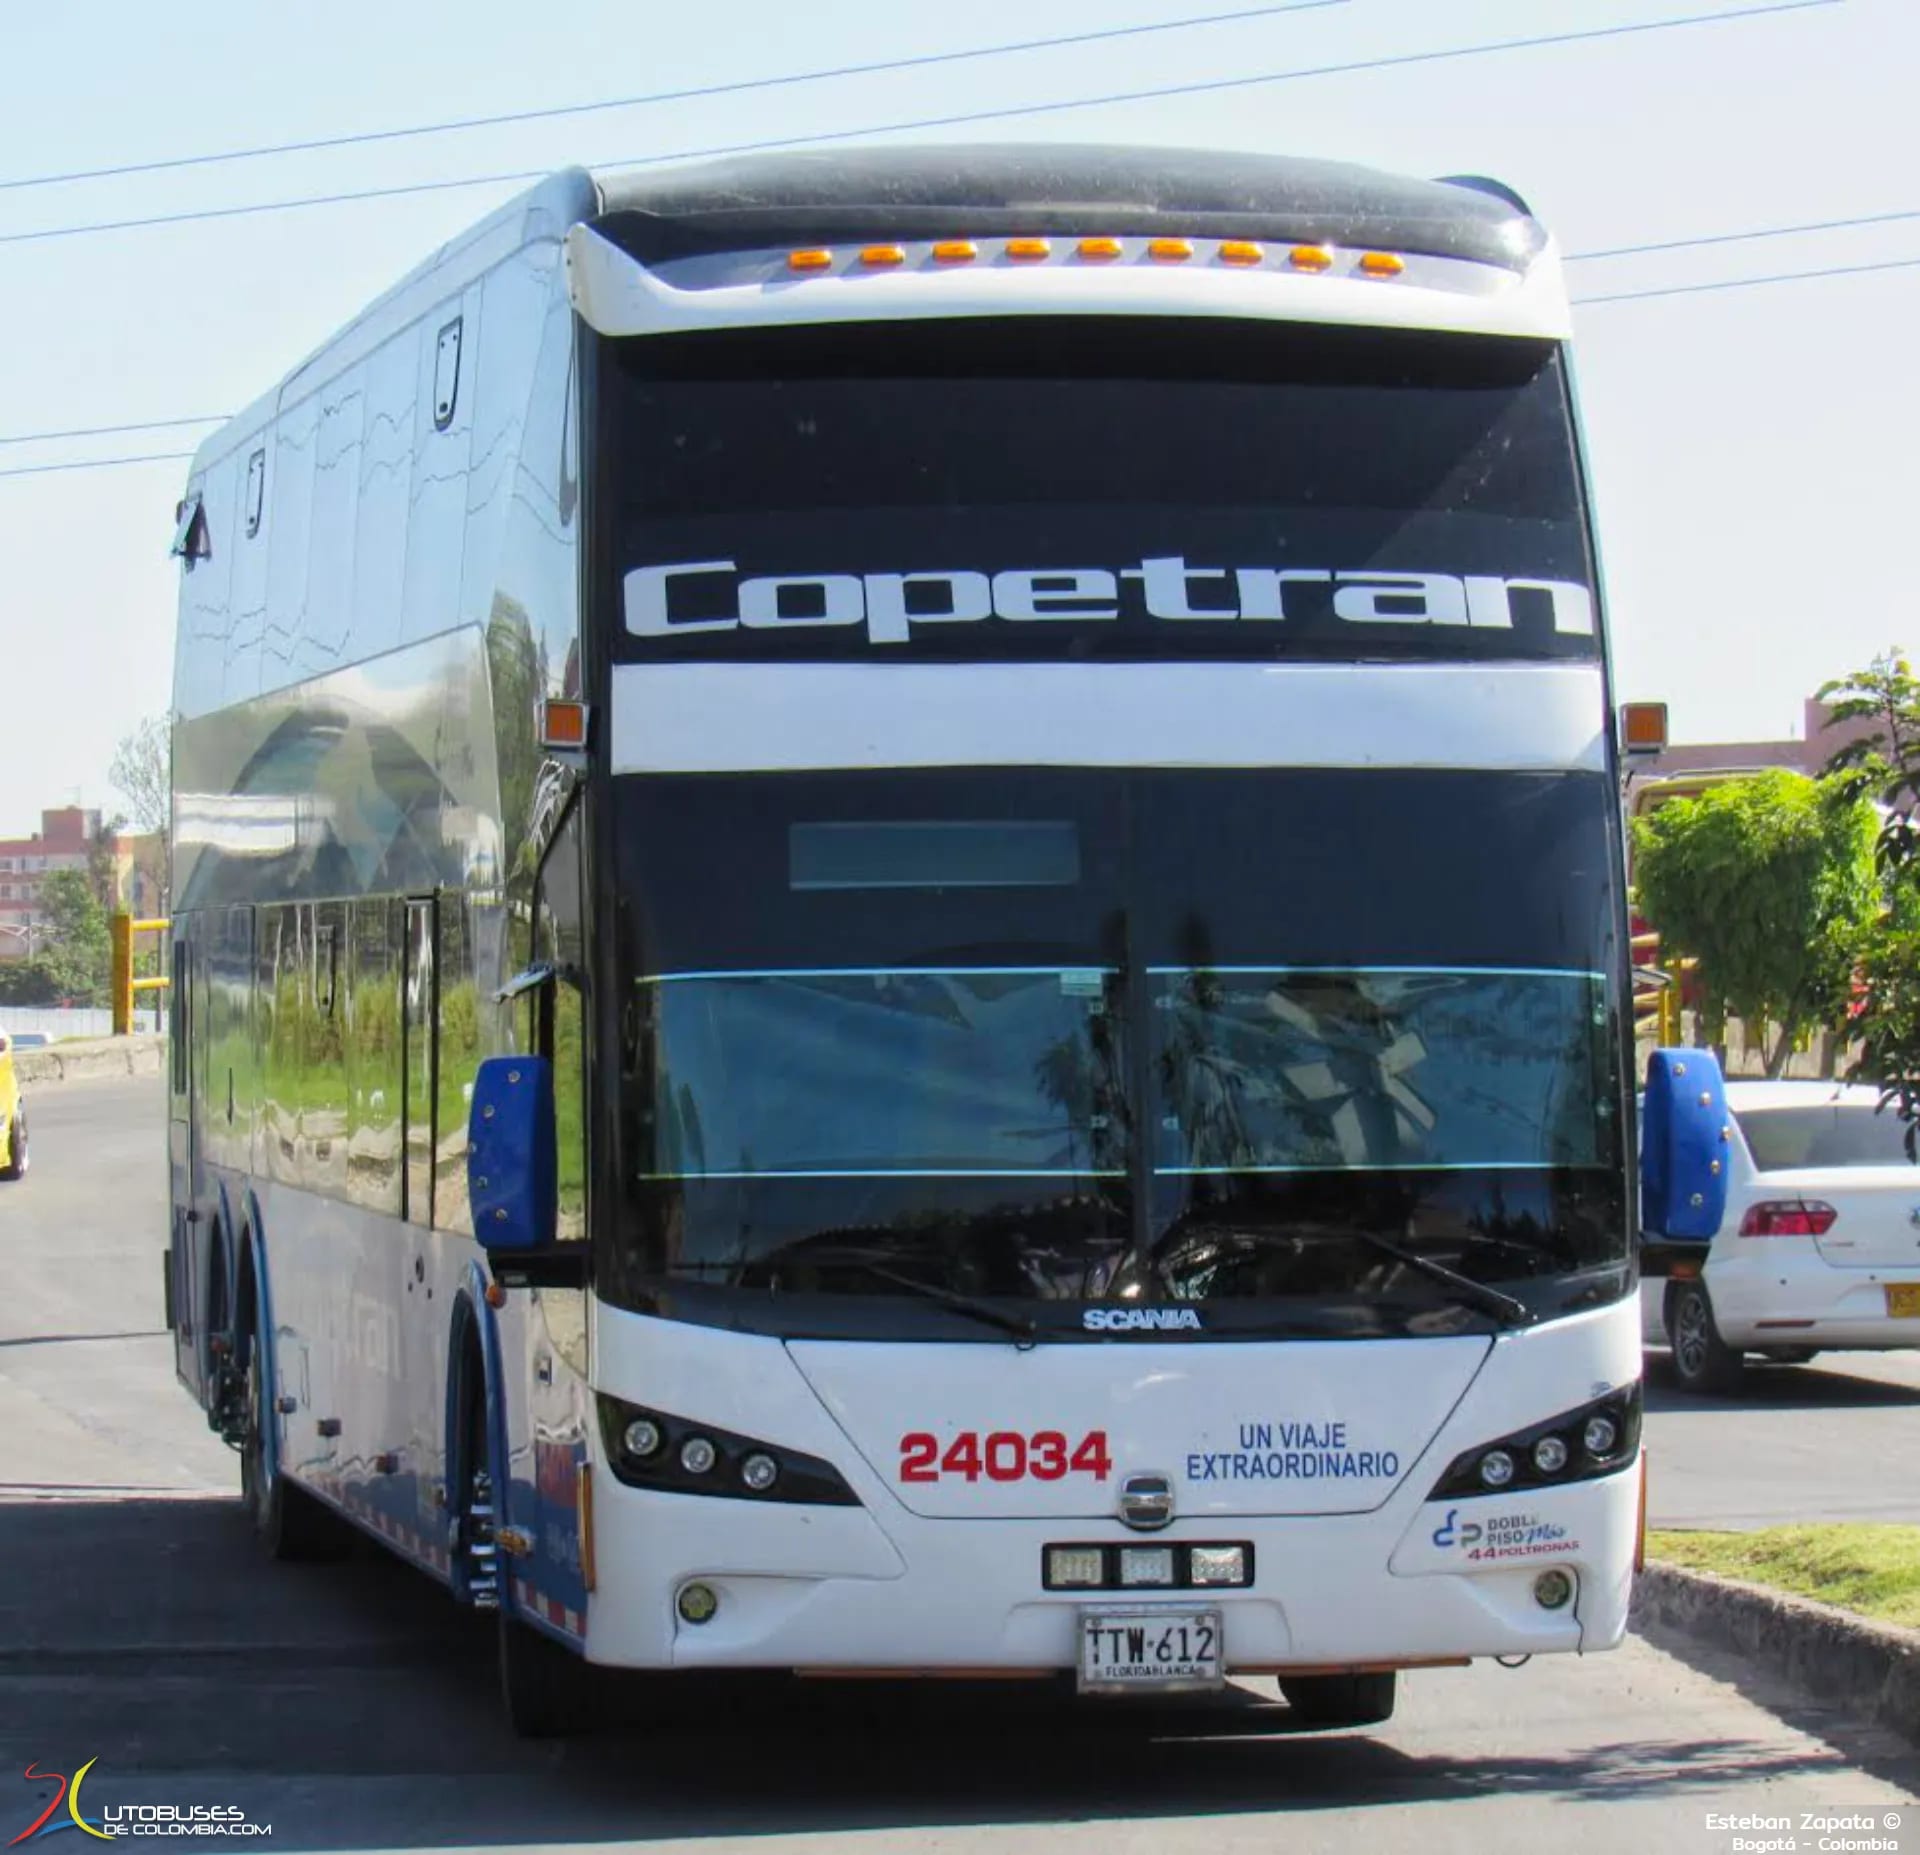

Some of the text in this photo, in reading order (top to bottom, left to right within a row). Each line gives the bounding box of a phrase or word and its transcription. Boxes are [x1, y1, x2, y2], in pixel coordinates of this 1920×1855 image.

[623, 556, 1594, 643] Copetran
[1083, 1308, 1202, 1330] SCANIA
[1240, 1422, 1346, 1449] UN VIAJE
[900, 1431, 1112, 1482] 24034
[1187, 1452, 1399, 1480] EXTRAORDINARIO
[1487, 1529, 1524, 1545] PISO
[1467, 1540, 1580, 1560] 44 POLTRONAS
[1105, 1664, 1196, 1678] FLORIDABLANCA
